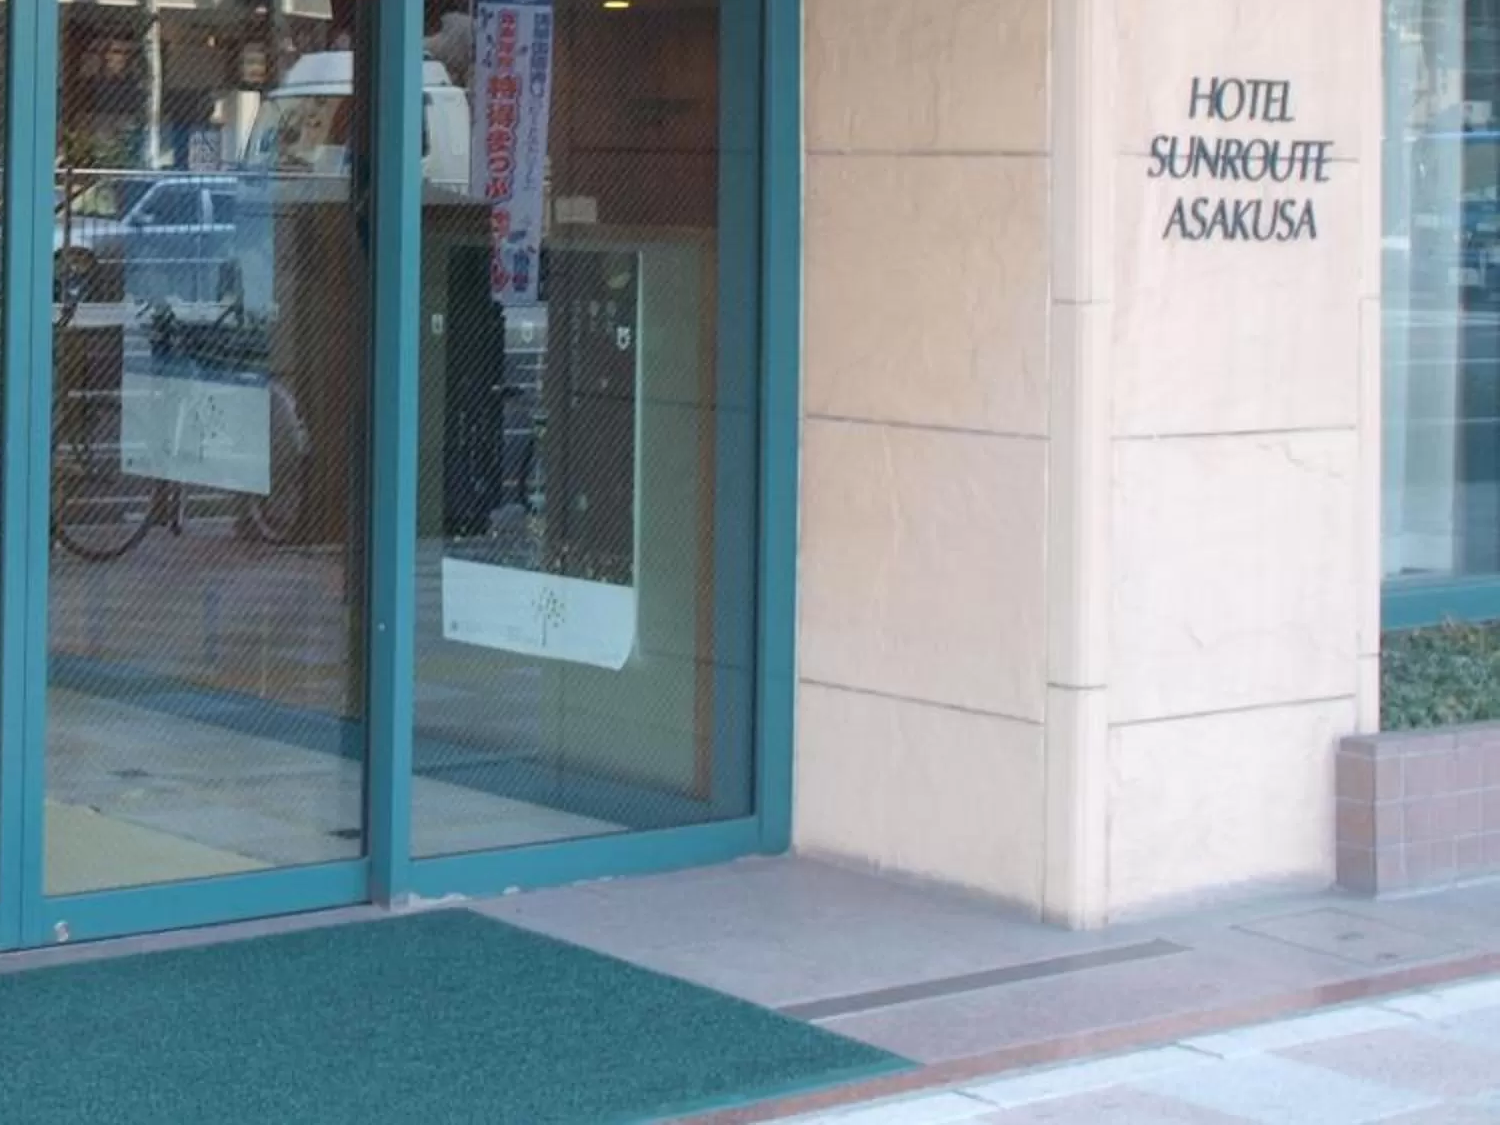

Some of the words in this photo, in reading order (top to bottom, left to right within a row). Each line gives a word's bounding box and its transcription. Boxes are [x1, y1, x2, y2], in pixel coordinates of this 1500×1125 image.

[1188, 76, 1295, 123] HOTEL
[1147, 133, 1334, 182] SUNROUTE
[1162, 196, 1317, 242] ASAKUSA
